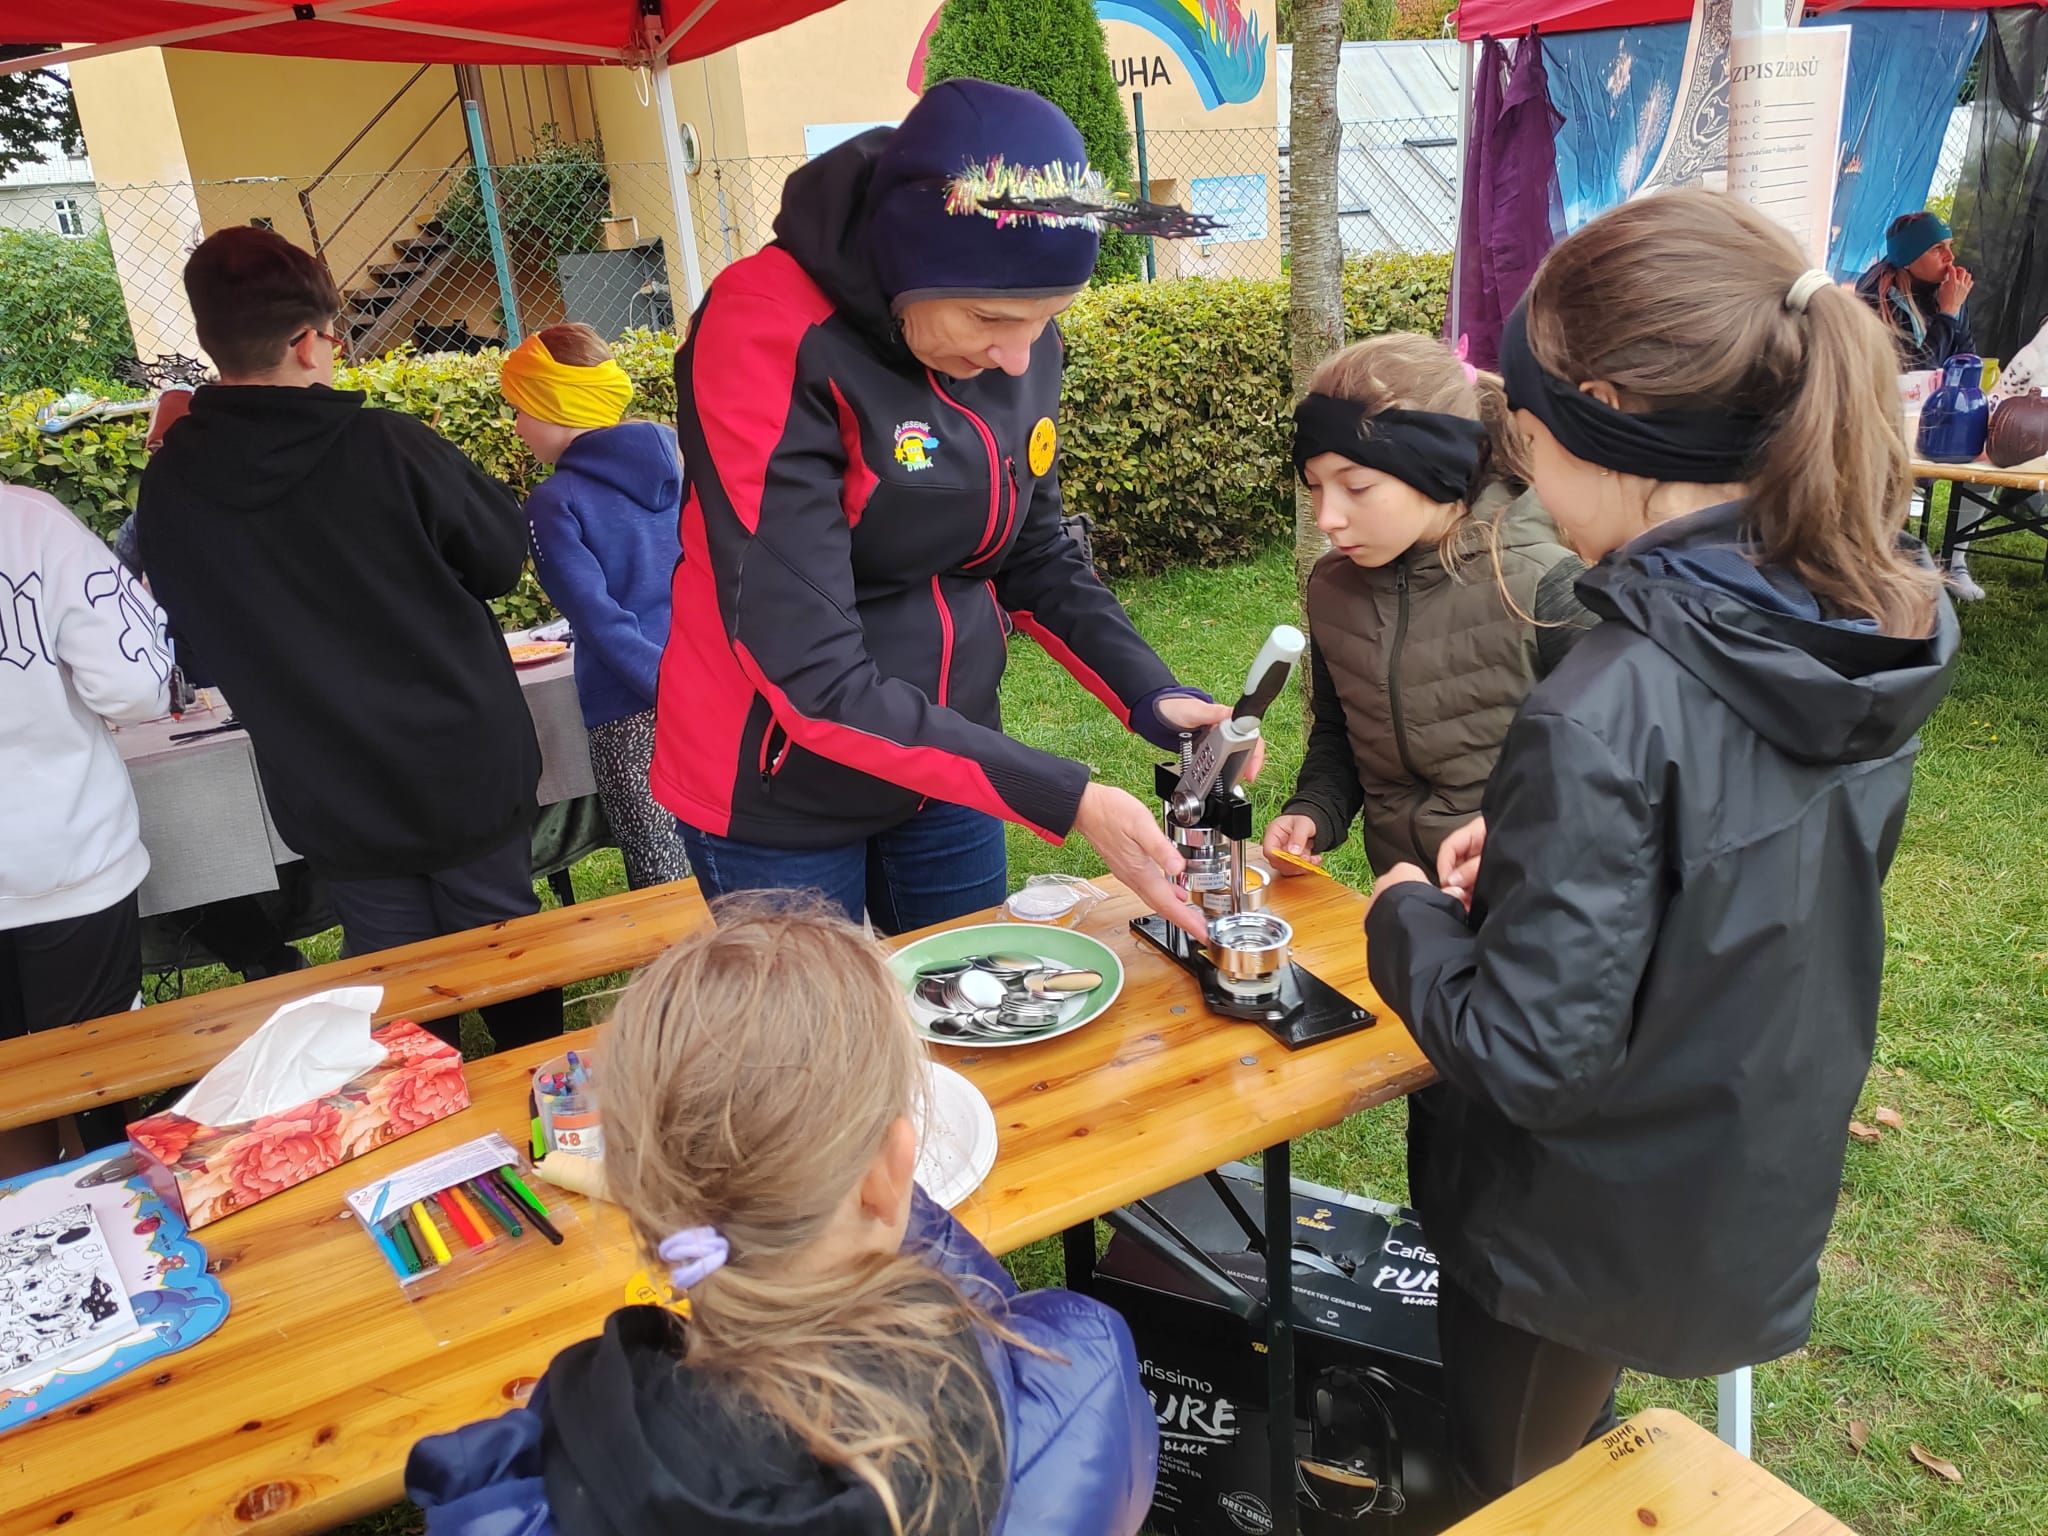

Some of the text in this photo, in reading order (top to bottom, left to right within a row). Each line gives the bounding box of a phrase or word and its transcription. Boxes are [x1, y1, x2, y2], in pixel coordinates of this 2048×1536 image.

[558, 1132, 581, 1146] 48
[1384, 1239, 1440, 1265] Cafis
[1163, 1440, 1209, 1457] BLACK
